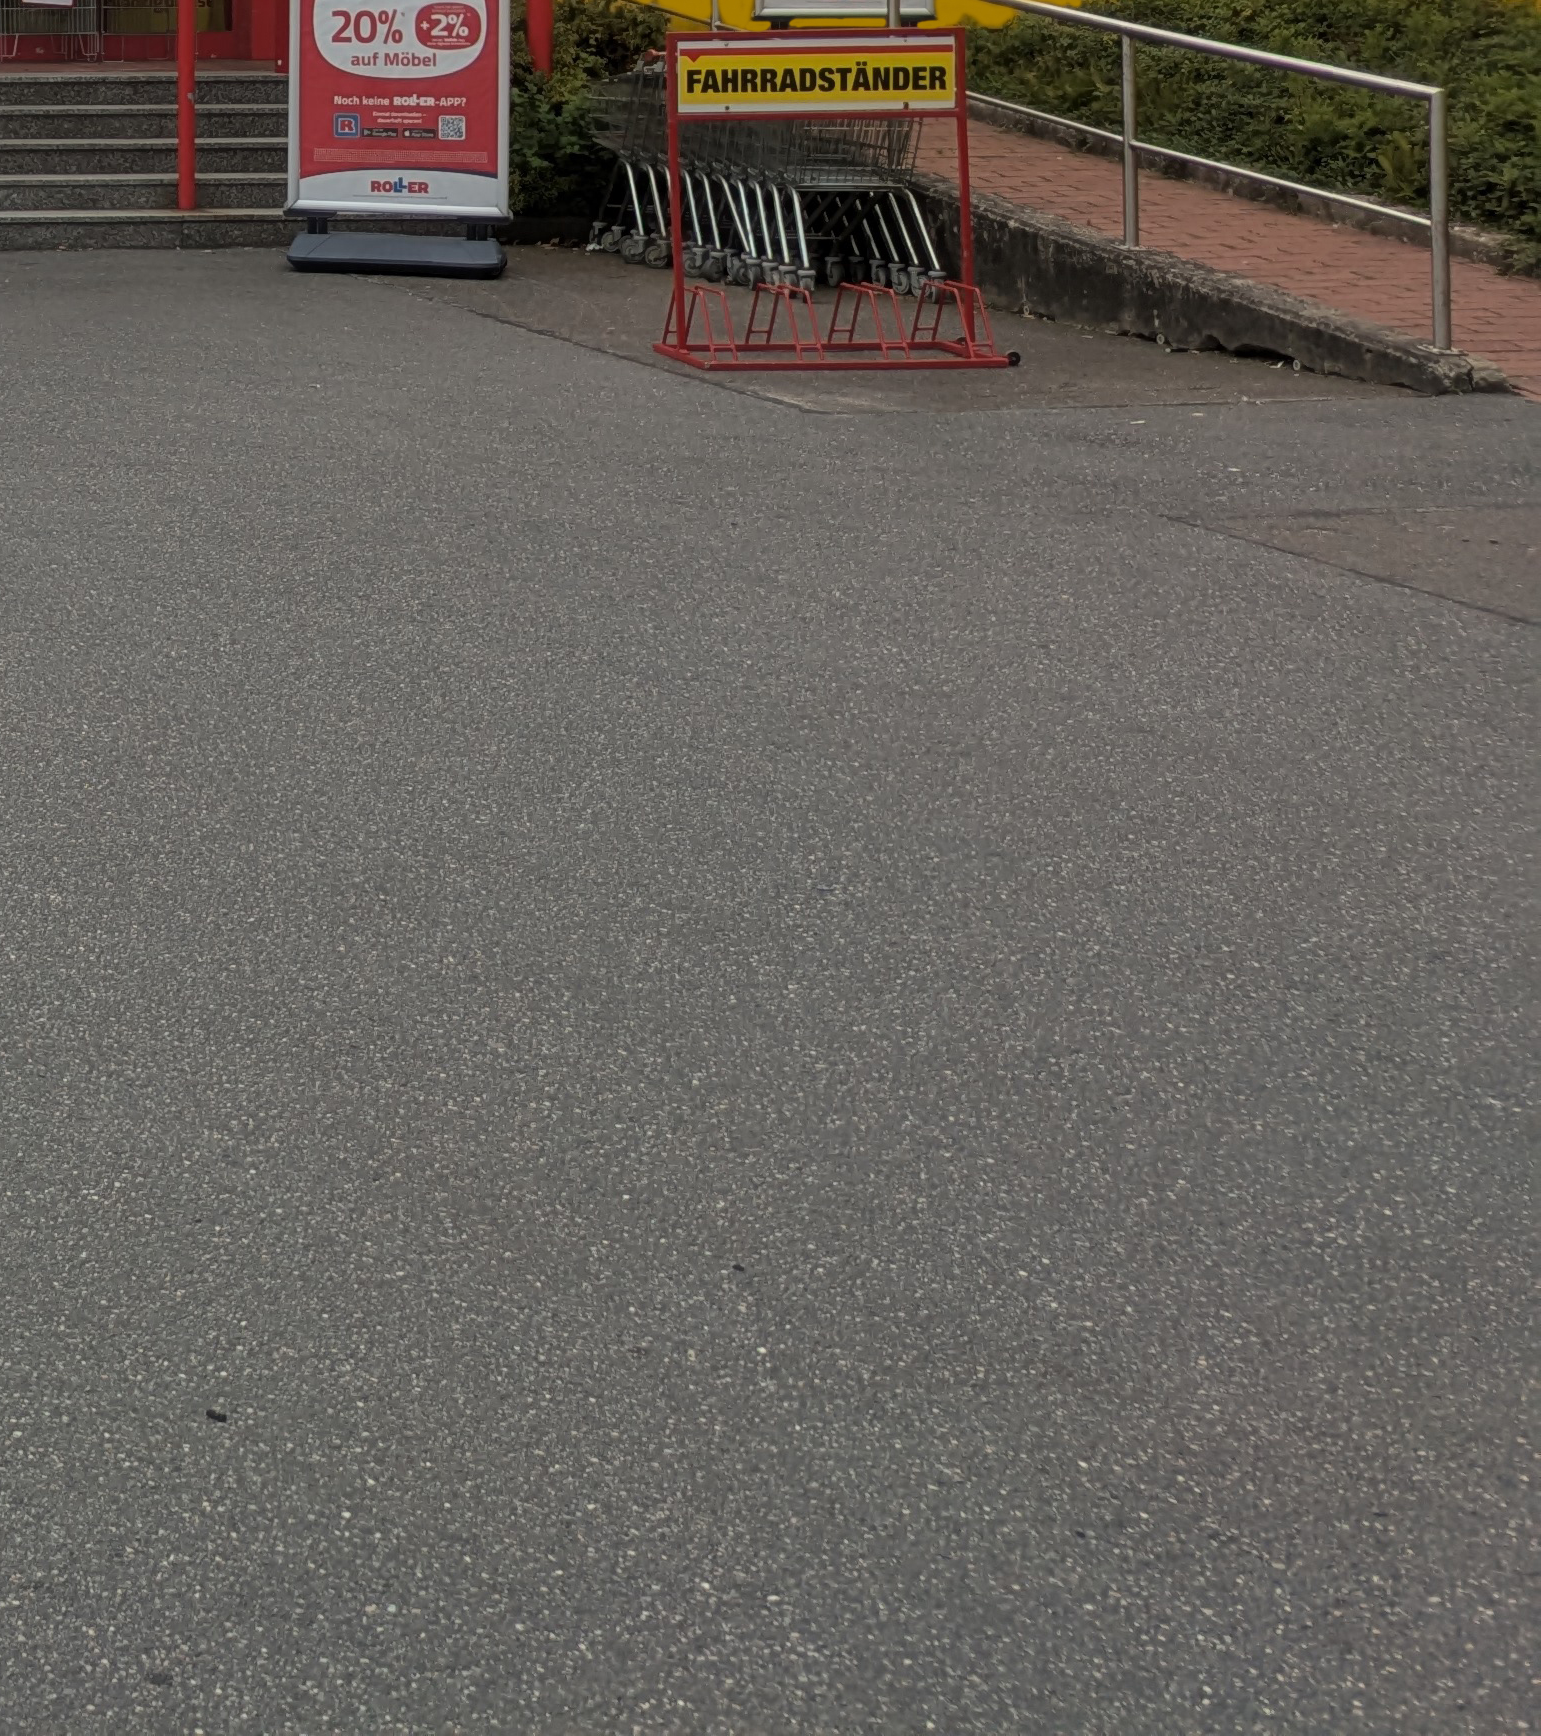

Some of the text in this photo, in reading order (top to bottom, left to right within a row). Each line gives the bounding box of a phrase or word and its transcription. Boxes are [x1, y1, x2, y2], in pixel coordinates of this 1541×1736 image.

[351, 52, 437, 67] auf Möbel
[686, 61, 947, 93] FAHRRADSTÄNDER
[333, 96, 360, 106] Noch
[362, 96, 390, 106] keine
[370, 177, 429, 194] ROLLER
